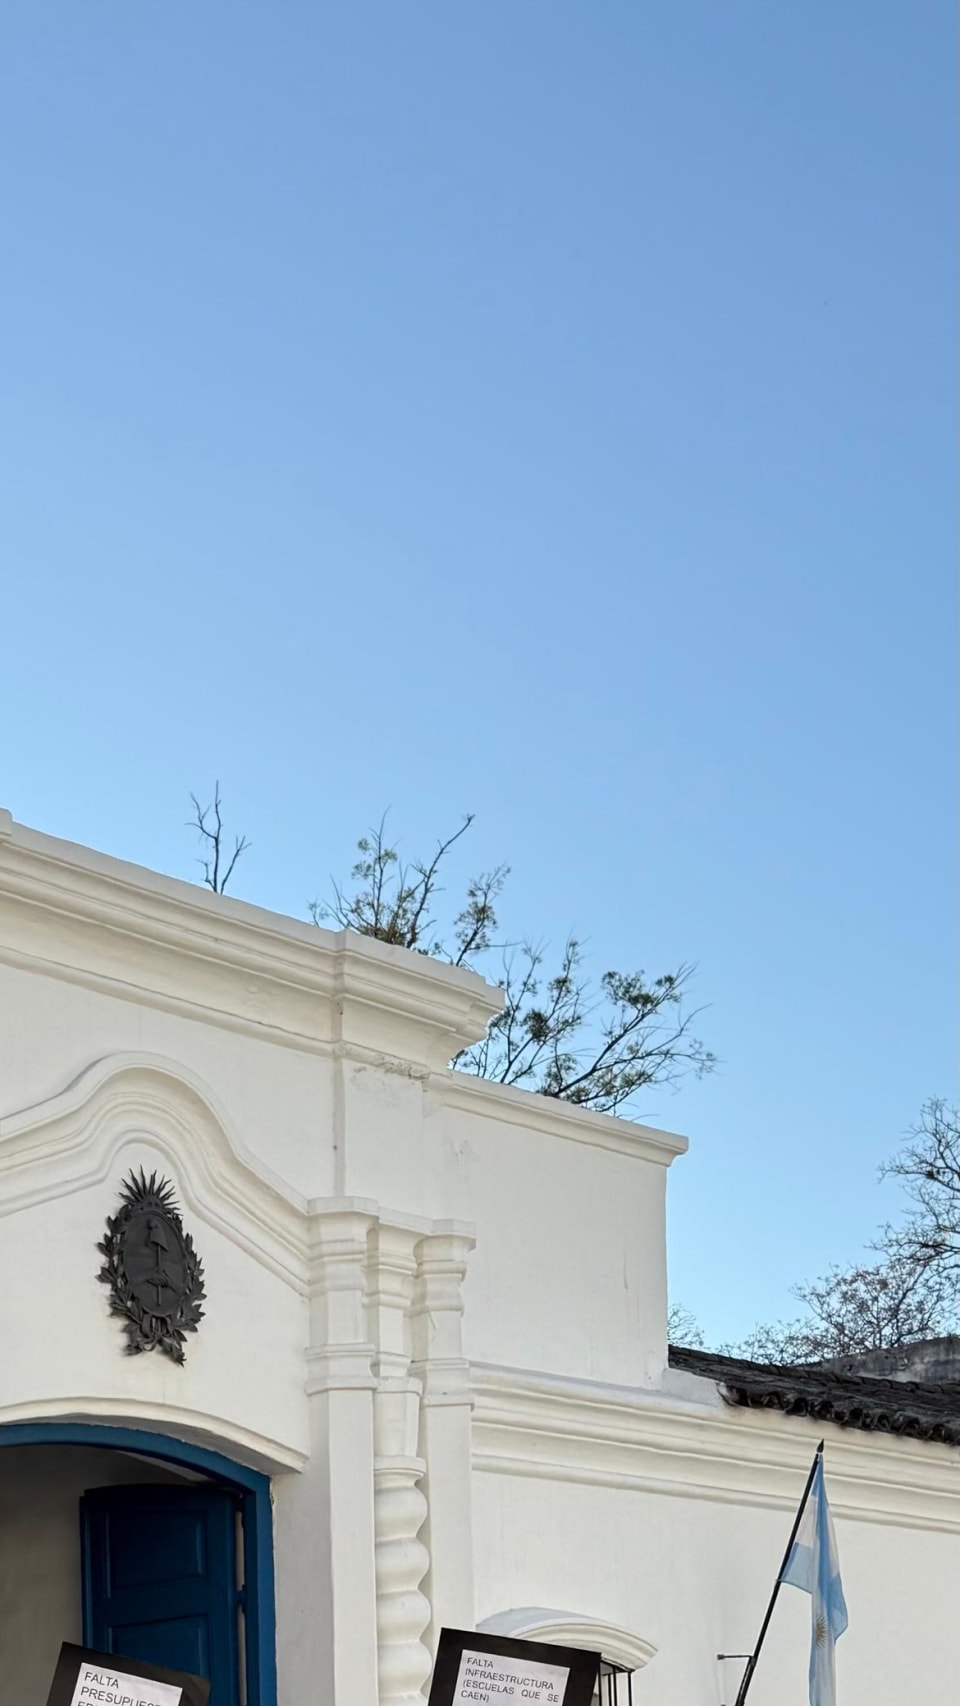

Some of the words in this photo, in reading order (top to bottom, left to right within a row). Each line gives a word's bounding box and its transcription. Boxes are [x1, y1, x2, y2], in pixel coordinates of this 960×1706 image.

[467, 1657, 494, 1668] FALTA
[84, 1671, 119, 1688] FALTA
[465, 1668, 554, 1690] INFRAESTRUCTURA
[461, 1690, 490, 1703] CAEN)
[463, 1679, 515, 1694] (ESCUELAS
[521, 1689, 540, 1700] QUE
[547, 1693, 559, 1702] SE
